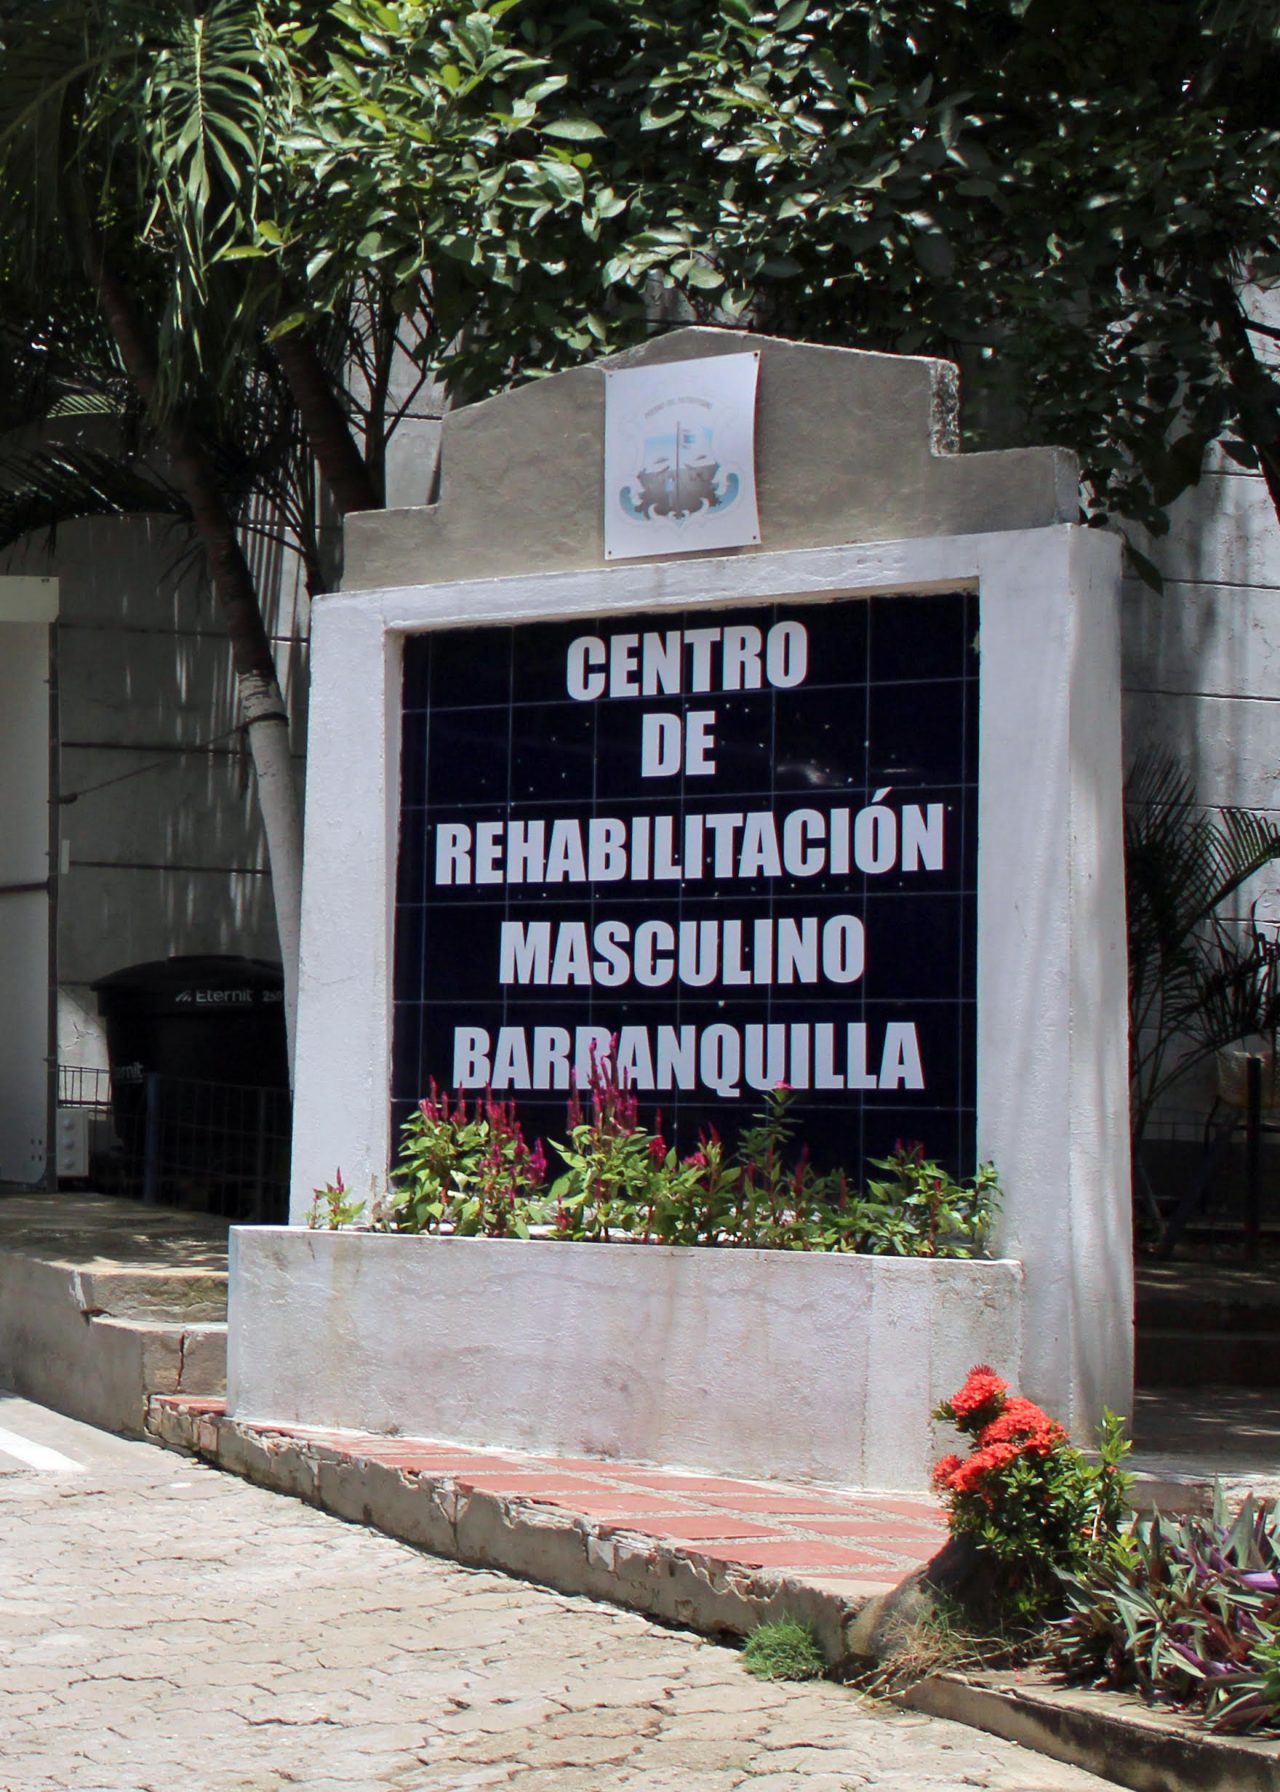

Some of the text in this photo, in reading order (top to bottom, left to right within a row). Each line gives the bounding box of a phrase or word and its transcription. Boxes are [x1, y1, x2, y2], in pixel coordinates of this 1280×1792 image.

[567, 620, 809, 701] CENTRO
[640, 711, 716, 778] DE
[435, 786, 944, 885] REHABILITACIÓN
[499, 914, 865, 987] MASCULINO
[195, 988, 254, 1003] Eternit
[452, 1022, 925, 1098] BARRANQUILLA
